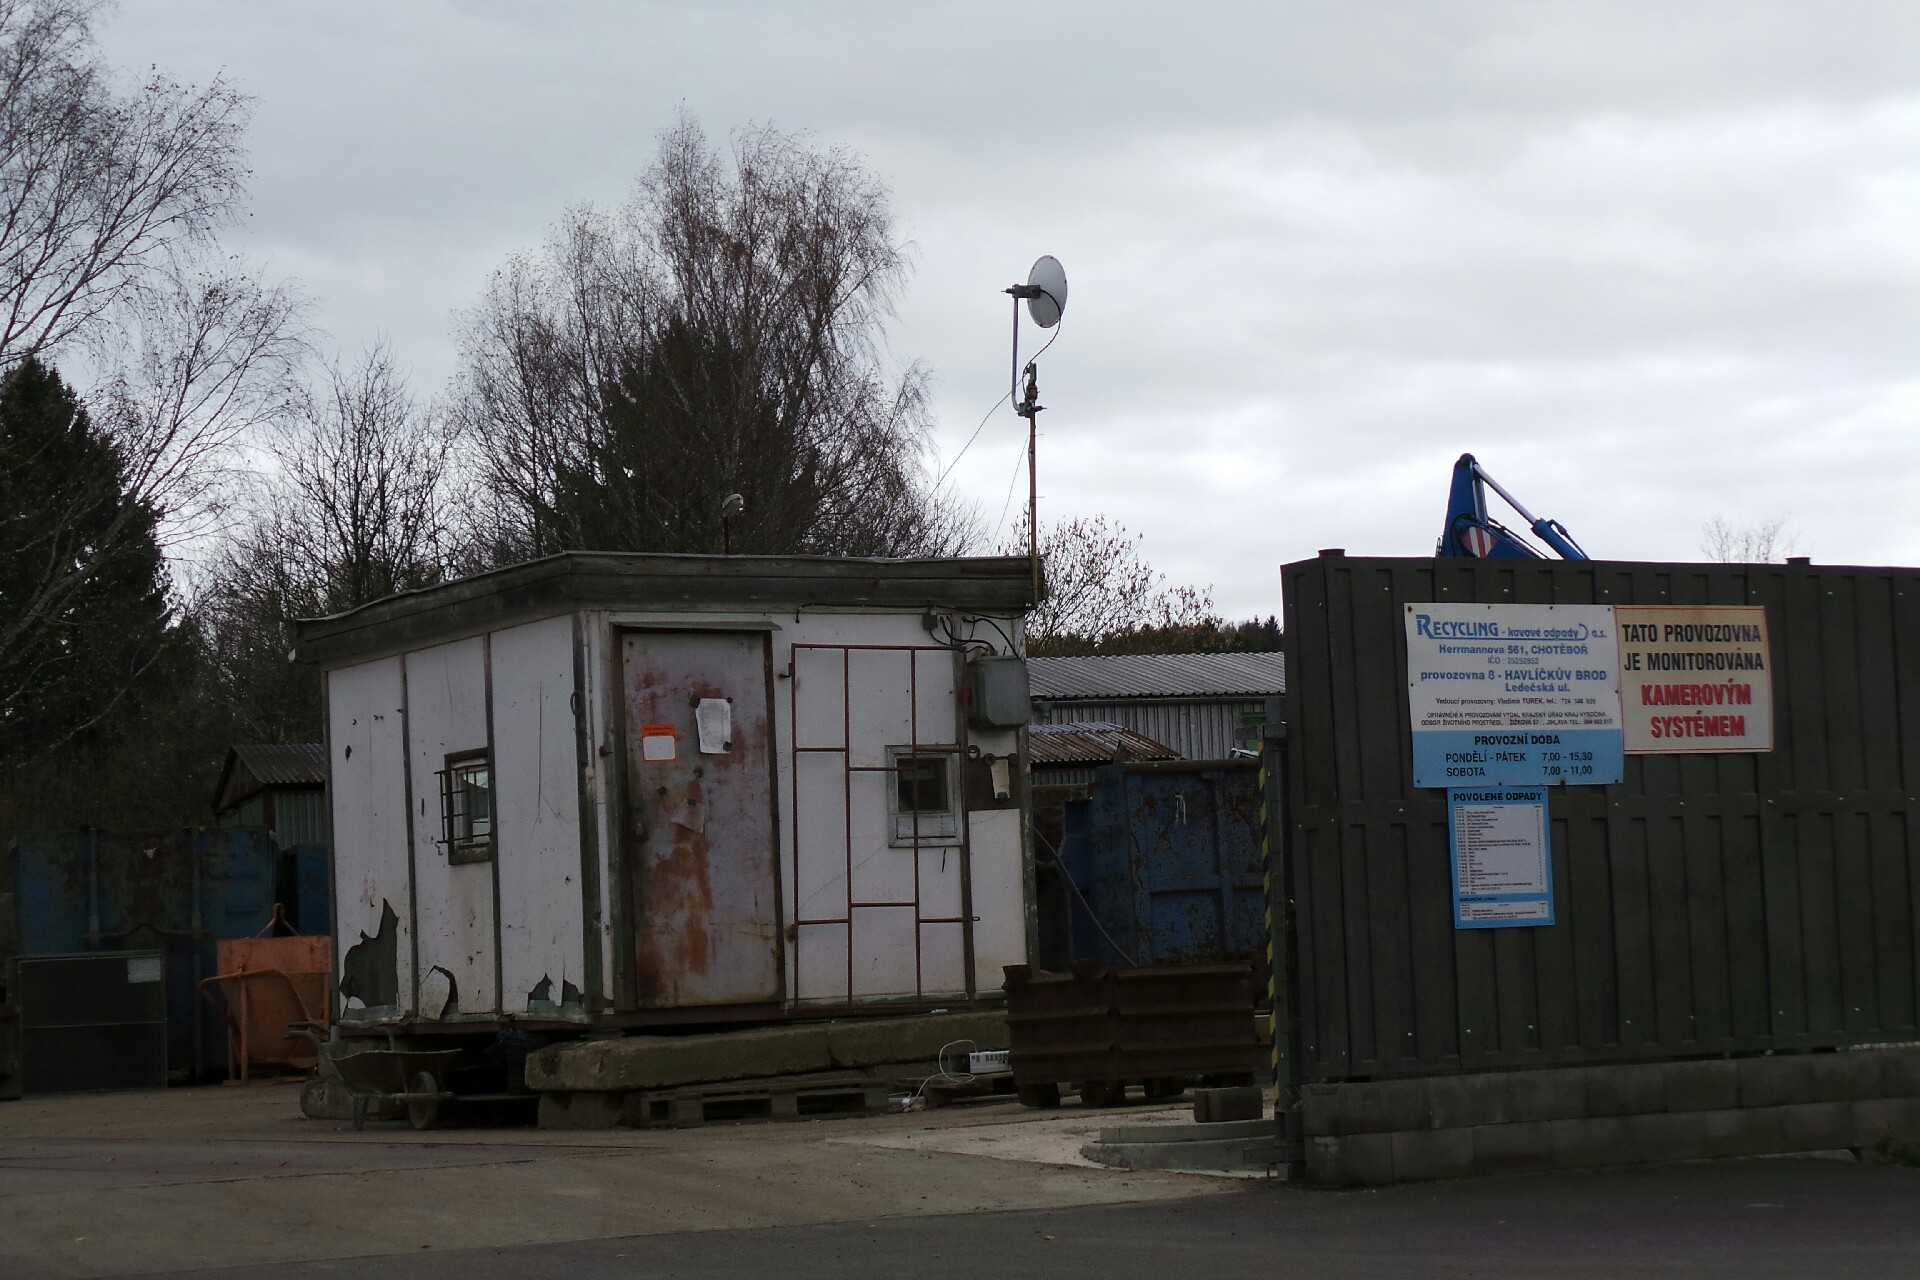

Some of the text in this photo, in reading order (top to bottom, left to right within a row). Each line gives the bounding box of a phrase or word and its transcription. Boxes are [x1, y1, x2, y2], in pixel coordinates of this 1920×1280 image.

[1416, 614, 1499, 639] RECYCLING
[1508, 627, 1541, 637] kovové
[1543, 628, 1579, 640] odpady
[1592, 630, 1607, 638] a.s.
[1622, 624, 1762, 642] TATO PROVOZOVNA
[1439, 643, 1588, 656] Herrmannova 561, CHOTĚBOŘ
[1624, 647, 1764, 671] JE MONITOROVÁNA
[1421, 671, 1485, 682] provozovna
[1488, 670, 1495, 680] 8
[1505, 667, 1571, 680] HAVLÍČKŮV
[1576, 670, 1607, 680] BROD
[1506, 683, 1571, 692] Ledečská ul.
[1641, 677, 1752, 705] KAMEROVÝM
[1651, 709, 1746, 737] SYSTÉMEM
[1474, 733, 1560, 745] PROVOZNÍ DOBA
[1445, 750, 1487, 763] PONDĚLÍ
[1495, 751, 1526, 762] PÁTEK
[1446, 767, 1486, 777] SOBOTA
[1453, 790, 1542, 801] POVOLENÉ ODPADY
